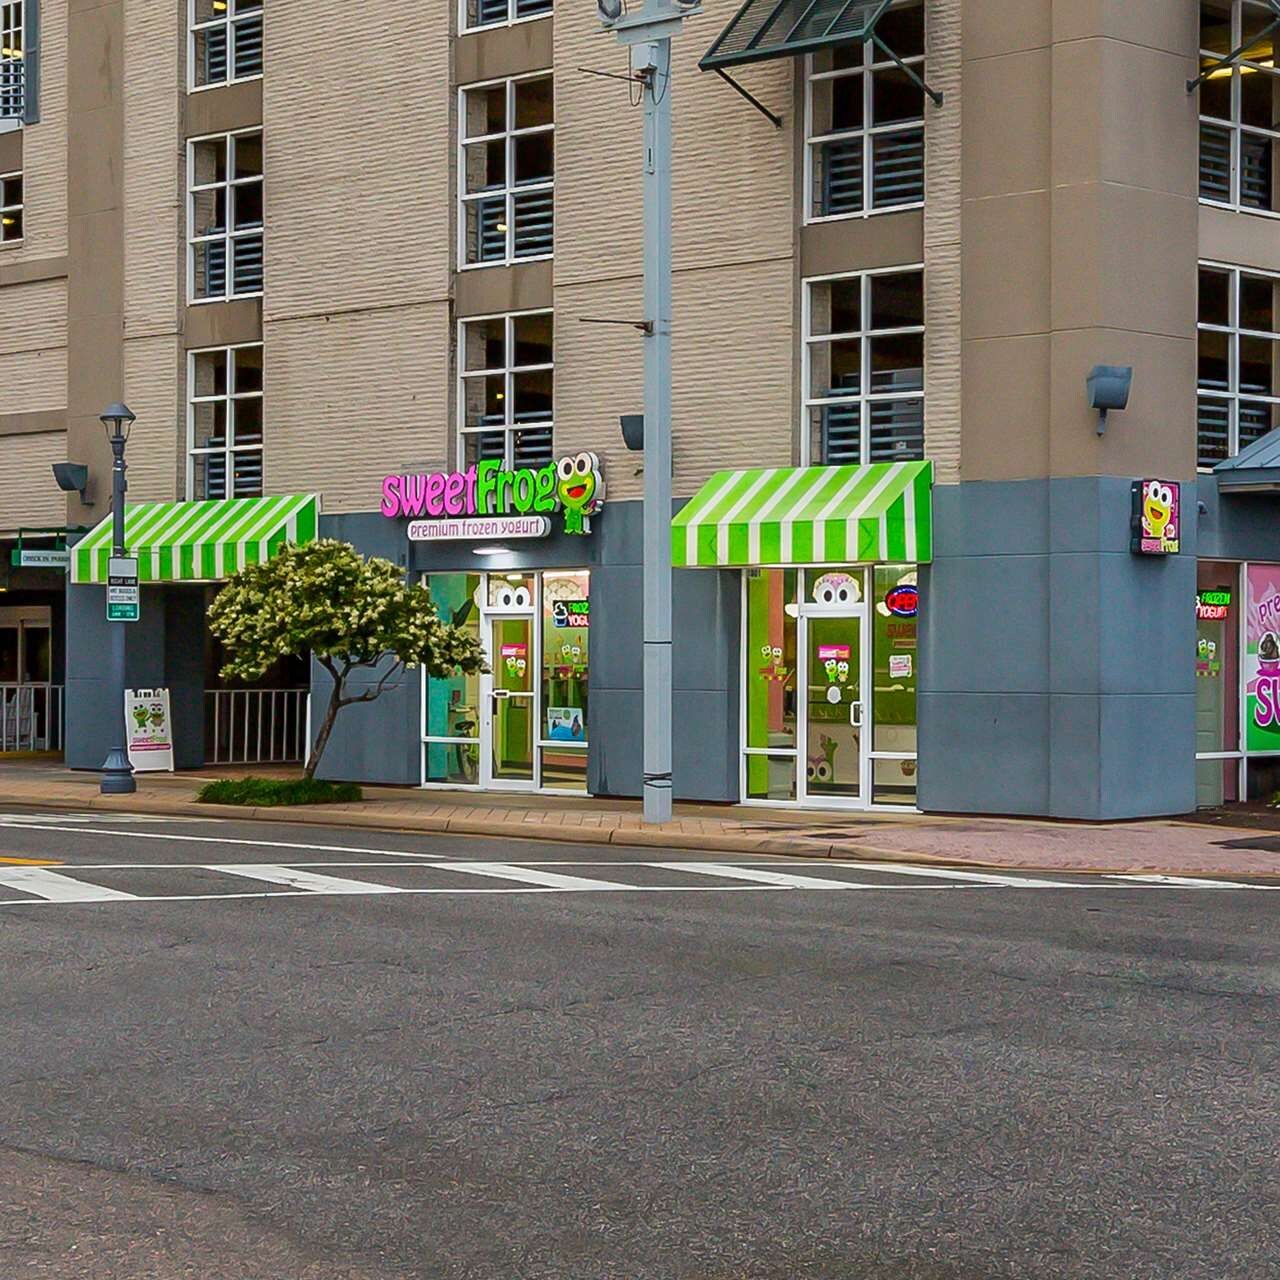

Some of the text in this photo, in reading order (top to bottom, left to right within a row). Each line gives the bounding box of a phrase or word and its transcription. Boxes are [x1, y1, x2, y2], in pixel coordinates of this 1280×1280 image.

[411, 519, 540, 538] premium frozen yogurt
[1201, 592, 1230, 605] FROZEN
